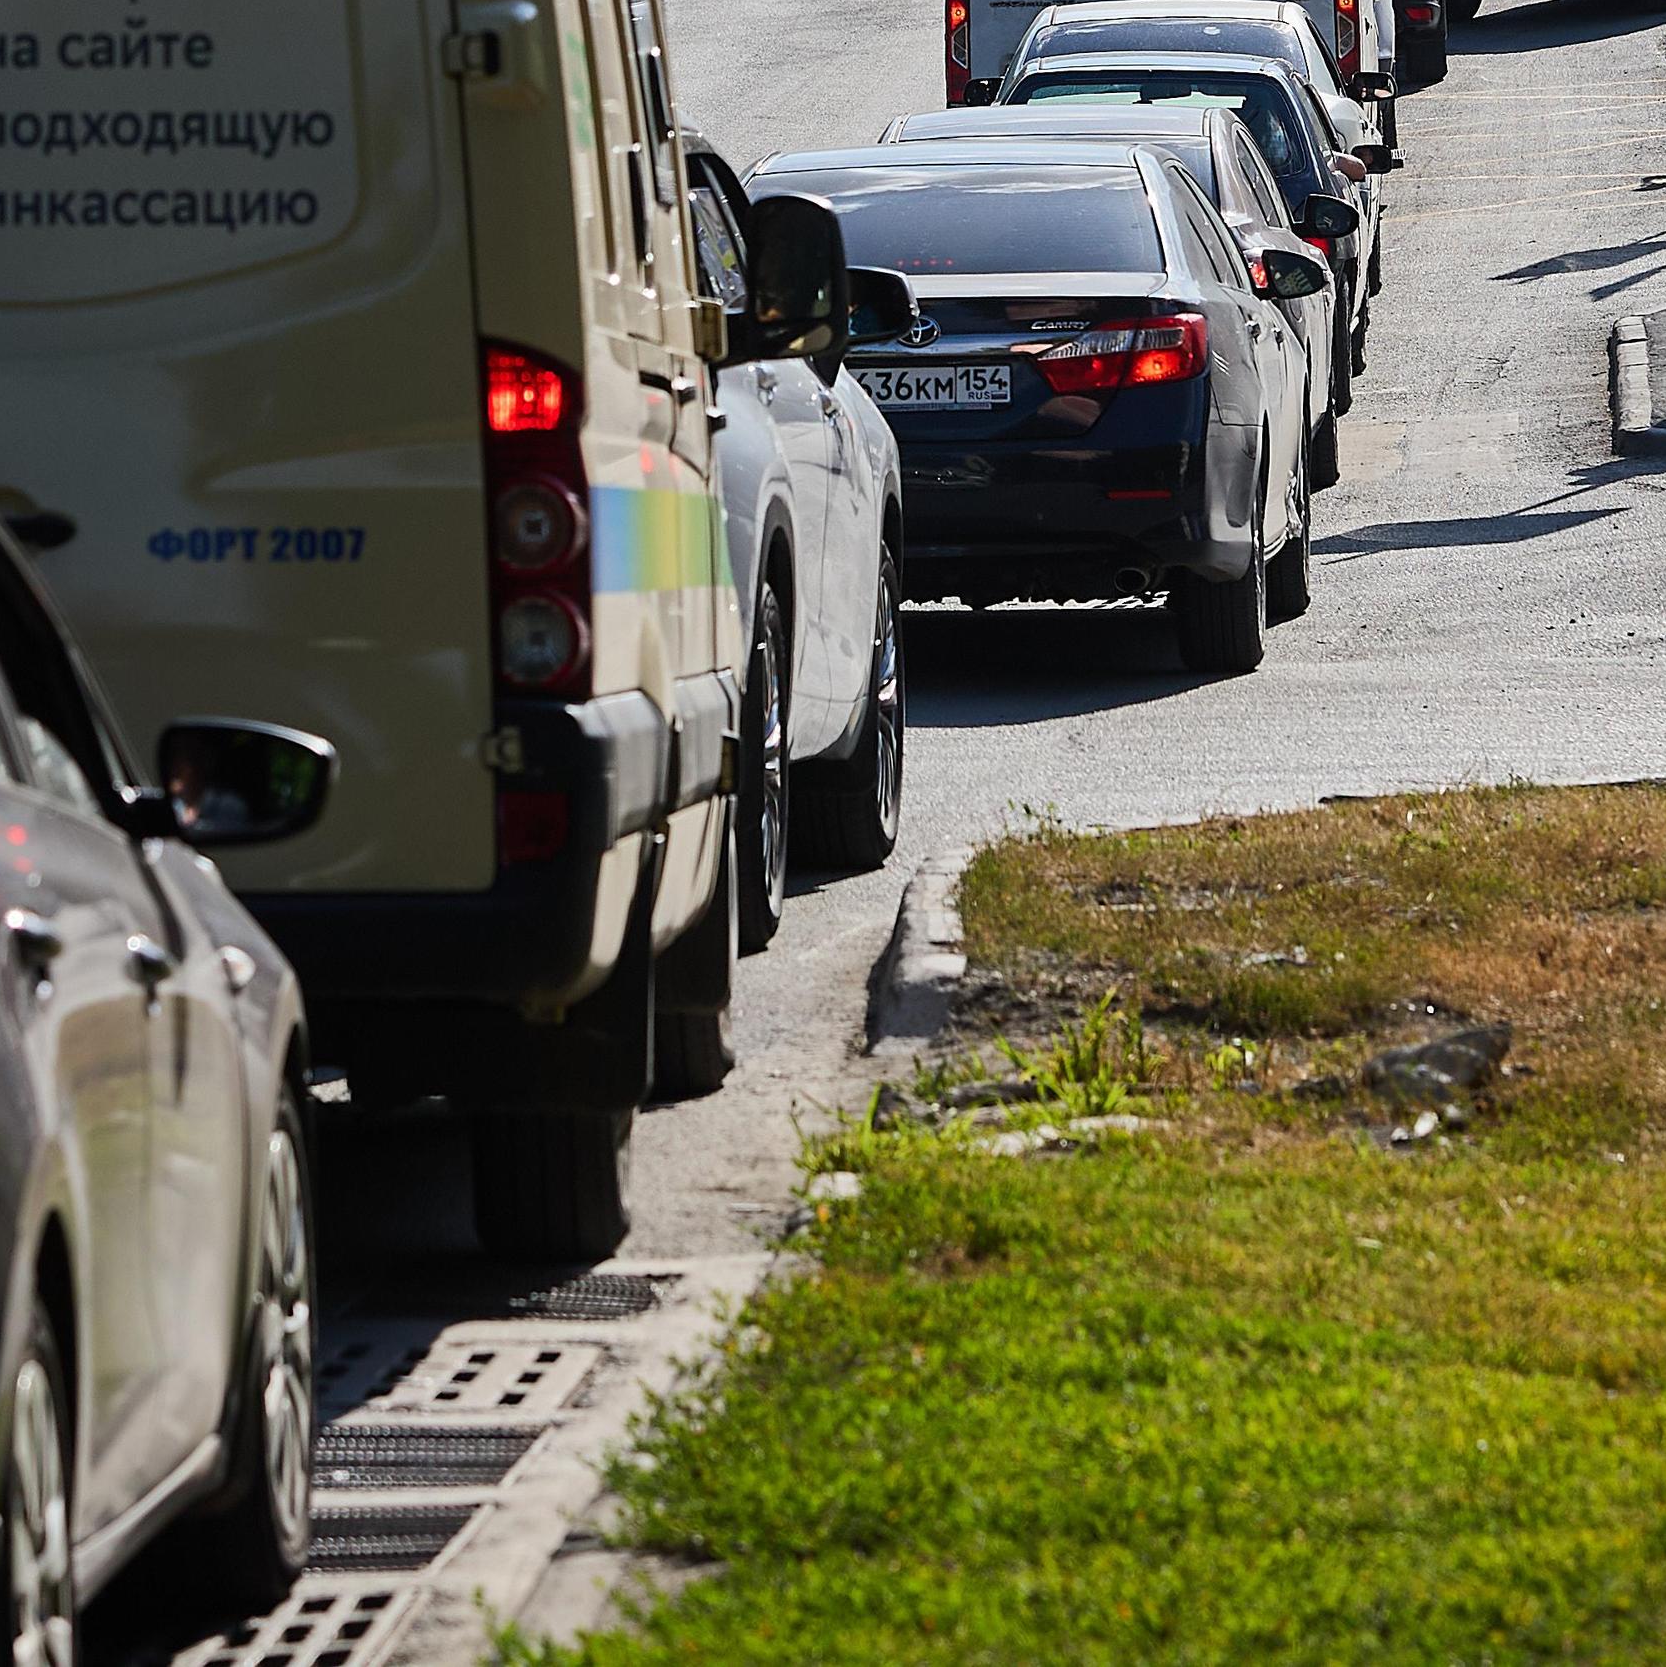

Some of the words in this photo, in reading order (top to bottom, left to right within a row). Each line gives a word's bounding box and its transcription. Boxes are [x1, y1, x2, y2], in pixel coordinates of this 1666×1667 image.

[58, 19, 214, 70] сайте
[857, 371, 954, 401] 636КМ
[958, 368, 1005, 391] 154
[968, 391, 990, 400] RUS
[147, 526, 259, 562] ФОРТ
[268, 528, 366, 562] 2007
